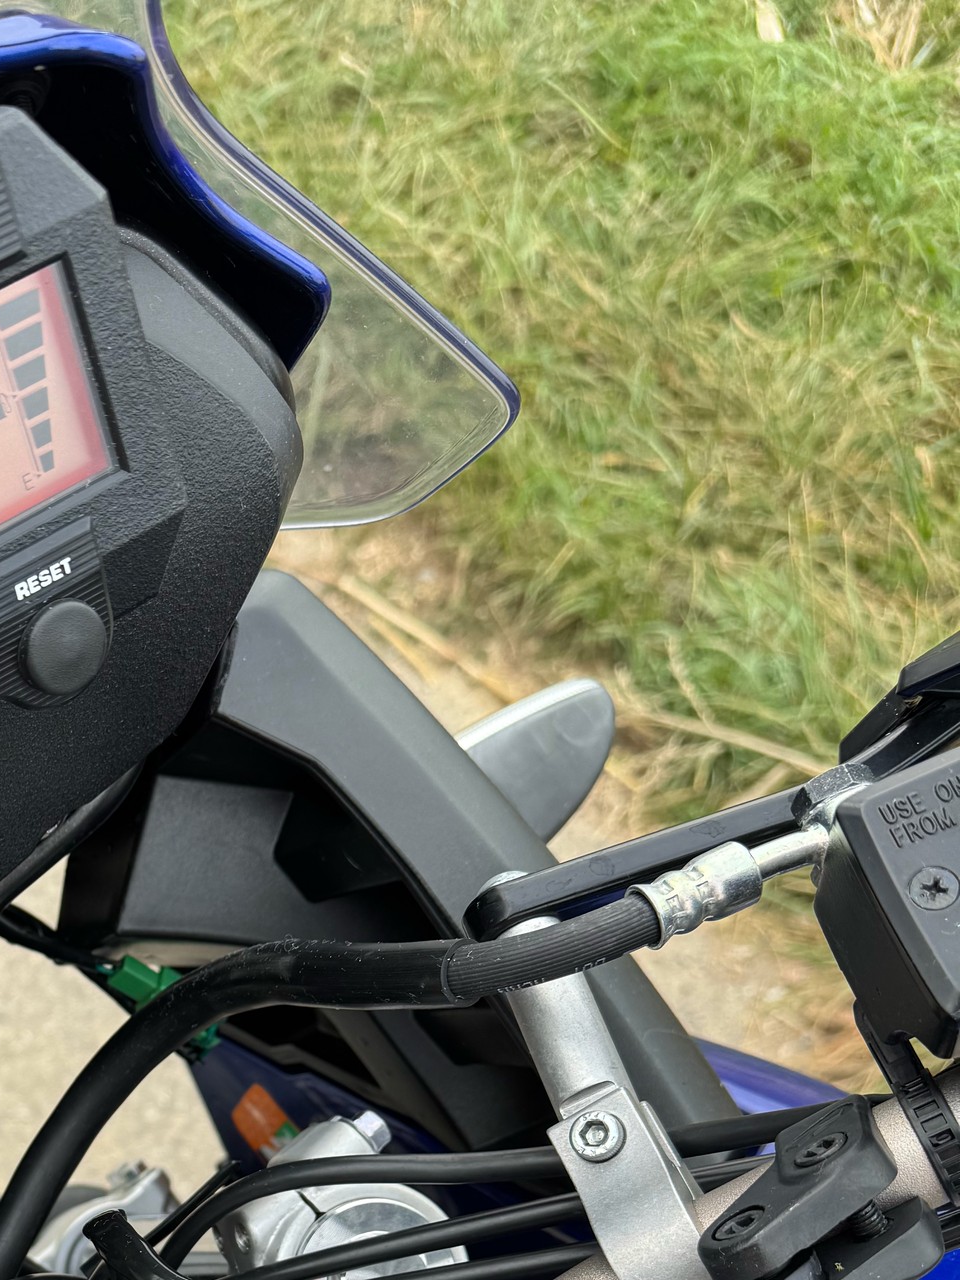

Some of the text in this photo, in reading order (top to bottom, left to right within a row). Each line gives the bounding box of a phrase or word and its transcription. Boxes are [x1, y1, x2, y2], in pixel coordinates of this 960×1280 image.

[22, 472, 35, 491] E
[14, 557, 72, 601] RESET
[878, 791, 927, 825] USE
[889, 807, 957, 848] FROM
